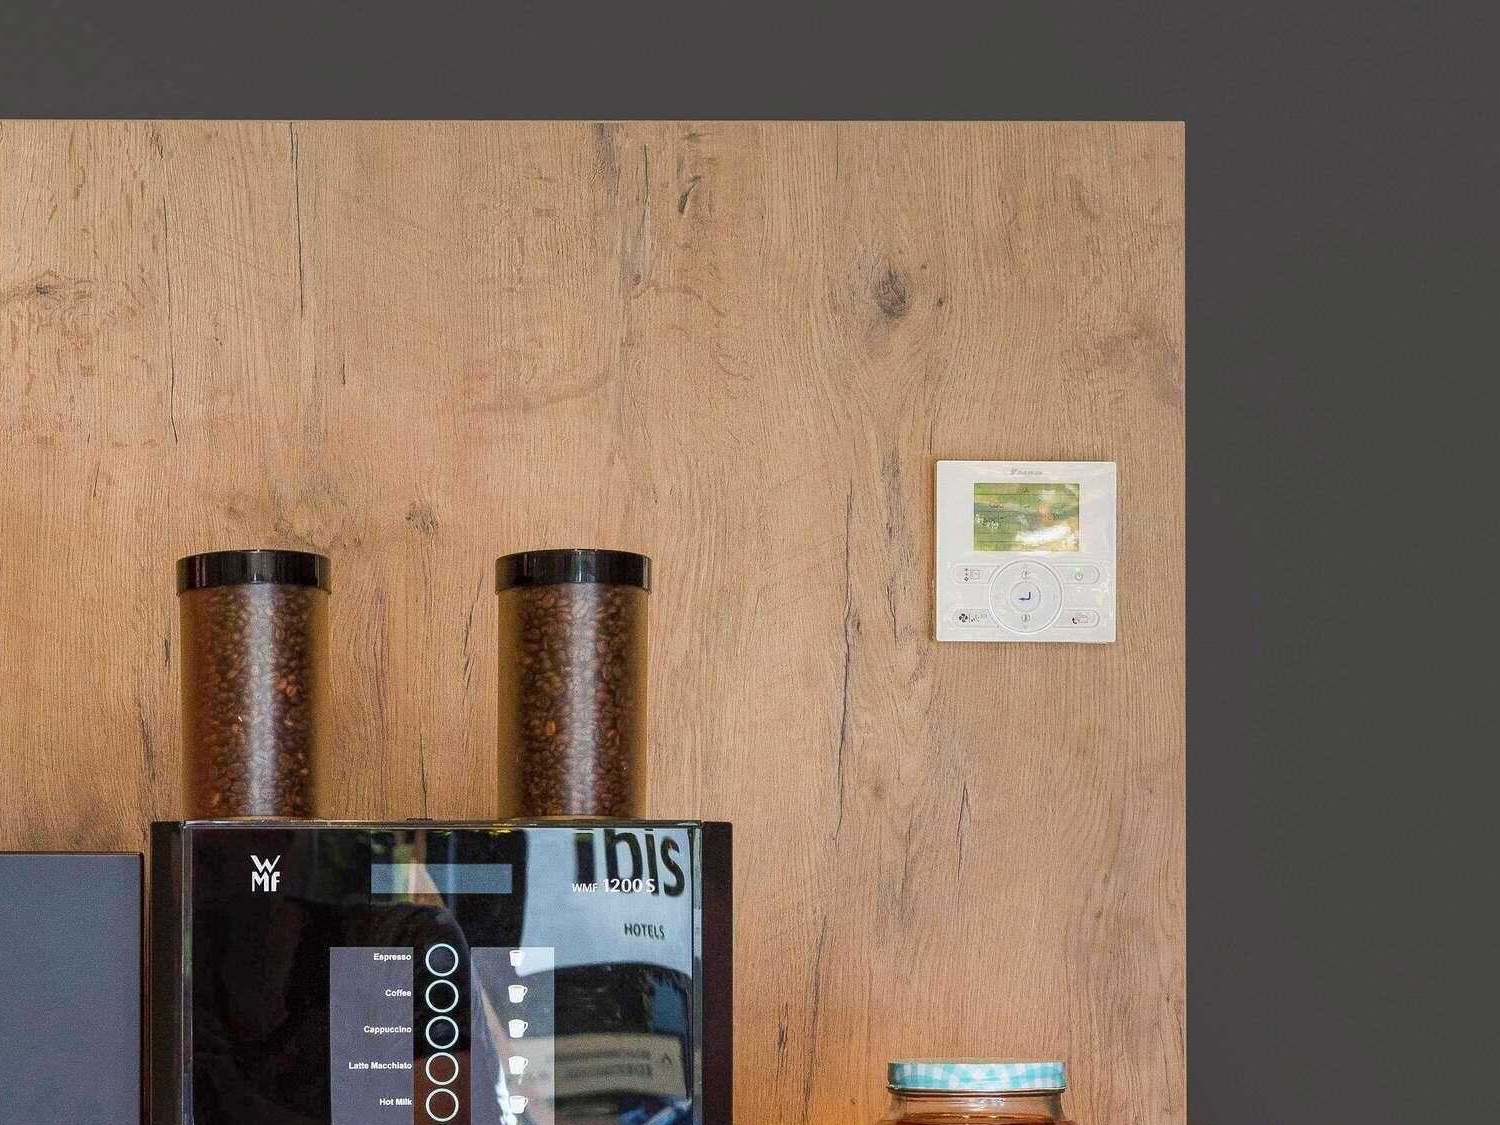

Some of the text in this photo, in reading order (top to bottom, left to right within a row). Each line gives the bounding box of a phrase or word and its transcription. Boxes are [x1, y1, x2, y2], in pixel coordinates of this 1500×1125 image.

[572, 878, 656, 893] WMF 1200 S
[623, 922, 665, 940] HOTELS
[373, 953, 412, 962] Espresso
[385, 988, 412, 997] Coffee
[363, 1025, 412, 1035] Cappuccino
[348, 1061, 412, 1070] Latte Macchiato
[379, 1098, 412, 1106] Hot Milk
